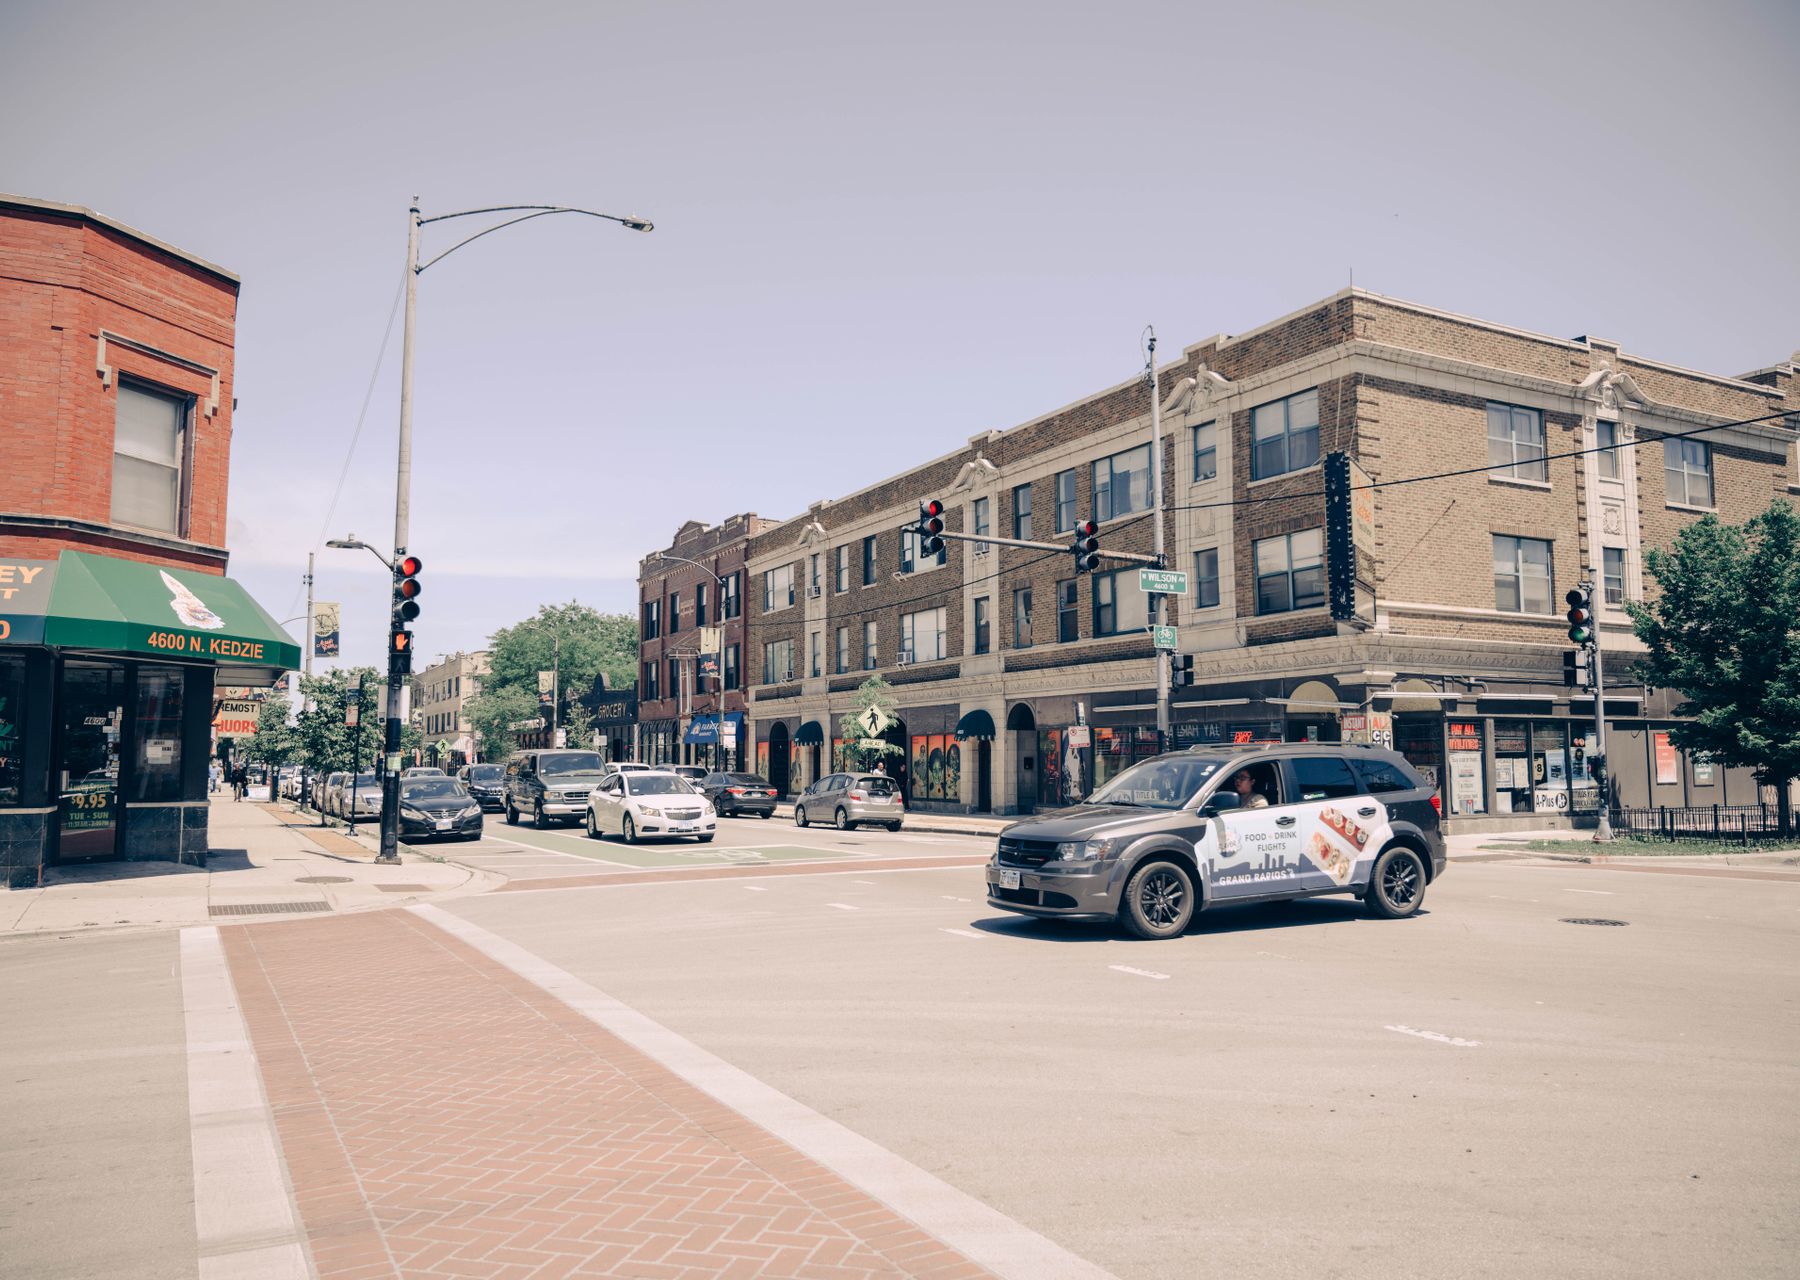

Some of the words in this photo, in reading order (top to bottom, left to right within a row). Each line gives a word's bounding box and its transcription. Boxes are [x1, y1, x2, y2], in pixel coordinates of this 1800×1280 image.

[1148, 573, 1177, 584] WILSON
[147, 631, 186, 651] 4600
[190, 636, 205, 652] N.
[210, 639, 264, 659] KEDZIE
[598, 702, 627, 719] GROCERY
[71, 794, 107, 809] $9.95
[1536, 794, 1555, 808] A-Plus
[92, 811, 109, 819] SUN
[1245, 833, 1267, 841] FOOD
[1274, 831, 1297, 840] DRINK
[1257, 843, 1286, 852] FLIGHTS
[1219, 873, 1251, 886] GRAND
[1254, 870, 1287, 881] RAPIDS
